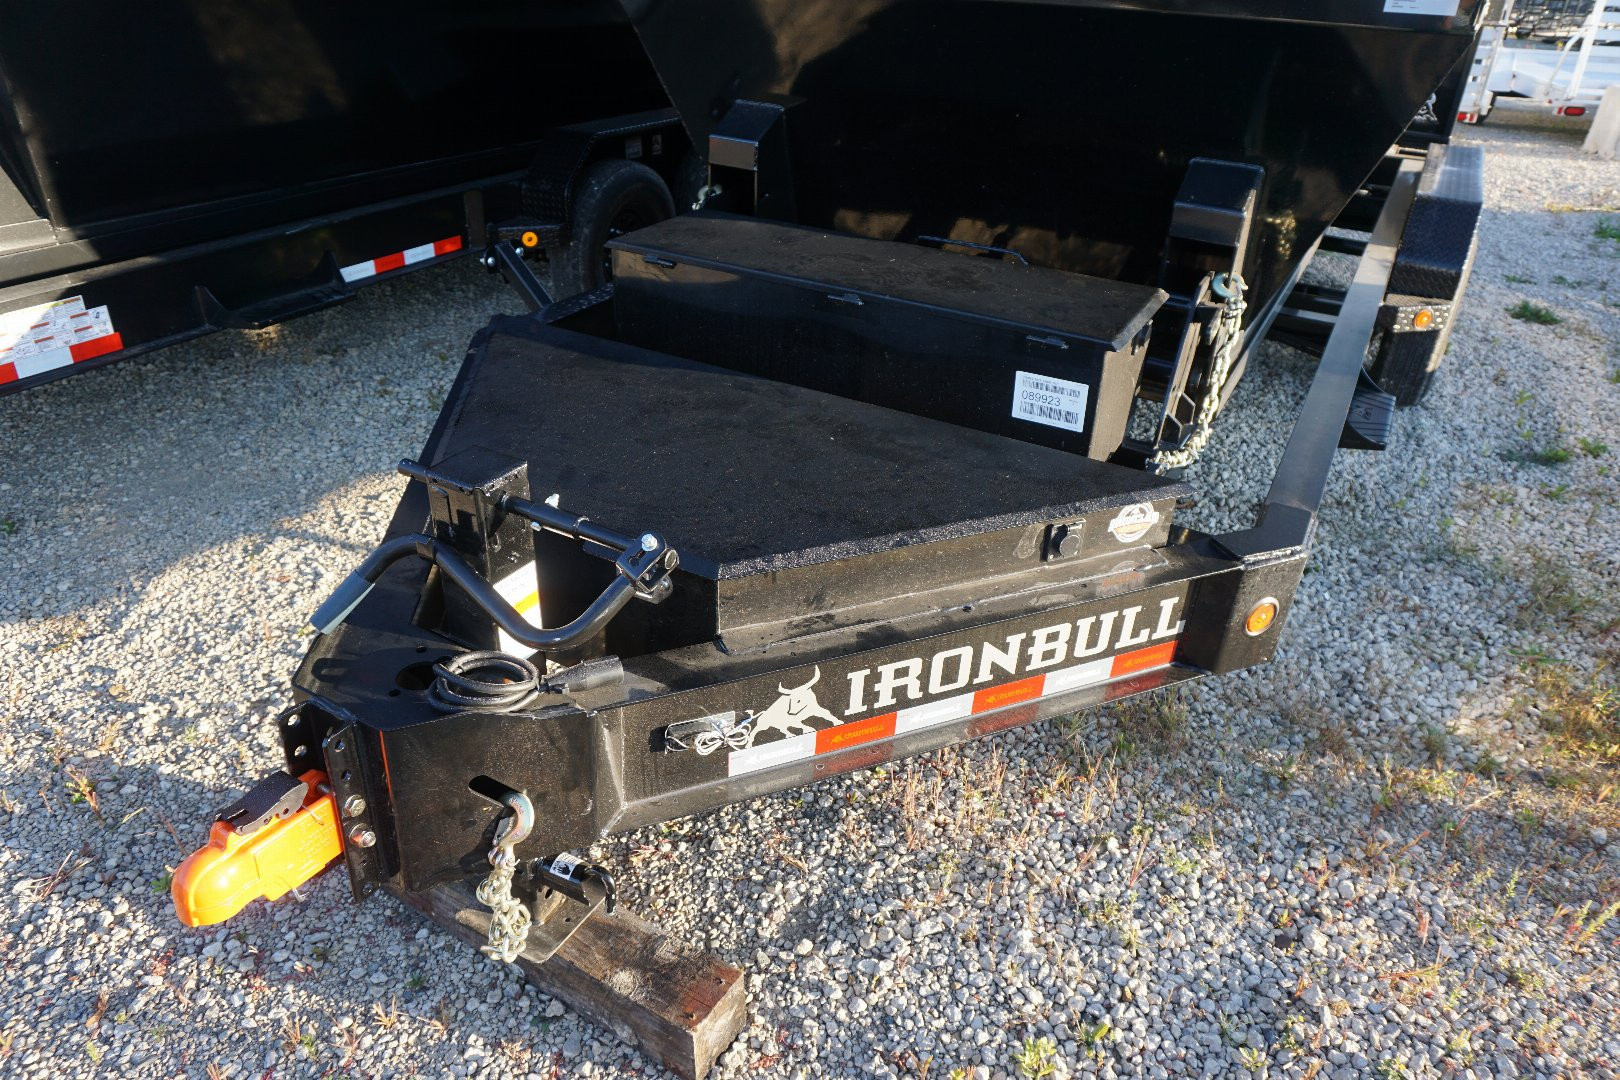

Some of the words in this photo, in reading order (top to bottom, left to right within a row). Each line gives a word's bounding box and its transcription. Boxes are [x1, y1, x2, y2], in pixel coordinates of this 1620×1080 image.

[1022, 389, 1061, 407] 089923
[845, 597, 1186, 716] IRONBULL
[844, 725, 885, 740] IRONBULL
